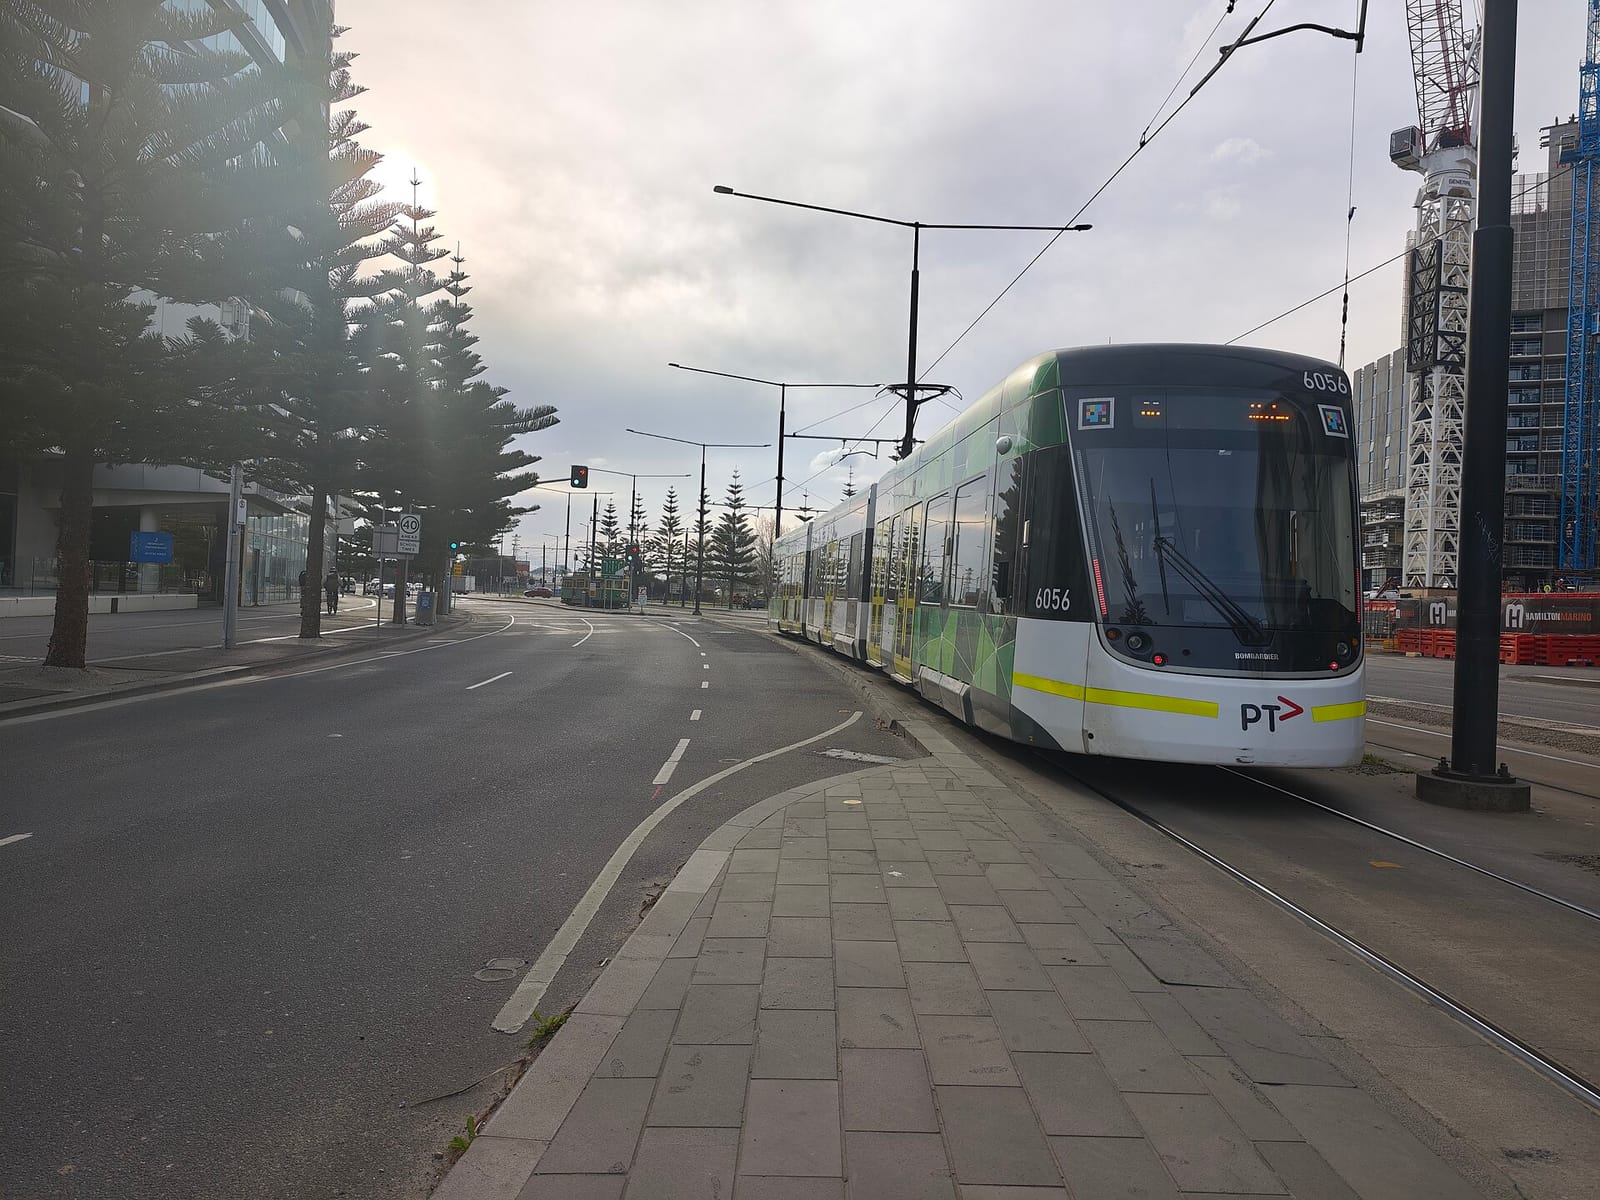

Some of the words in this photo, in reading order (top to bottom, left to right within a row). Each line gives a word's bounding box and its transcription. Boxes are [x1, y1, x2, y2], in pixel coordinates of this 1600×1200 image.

[1303, 371, 1347, 394] 6056
[403, 520, 417, 530] 40
[1035, 588, 1070, 611] 6056
[1234, 652, 1279, 660] BOMBARDIER
